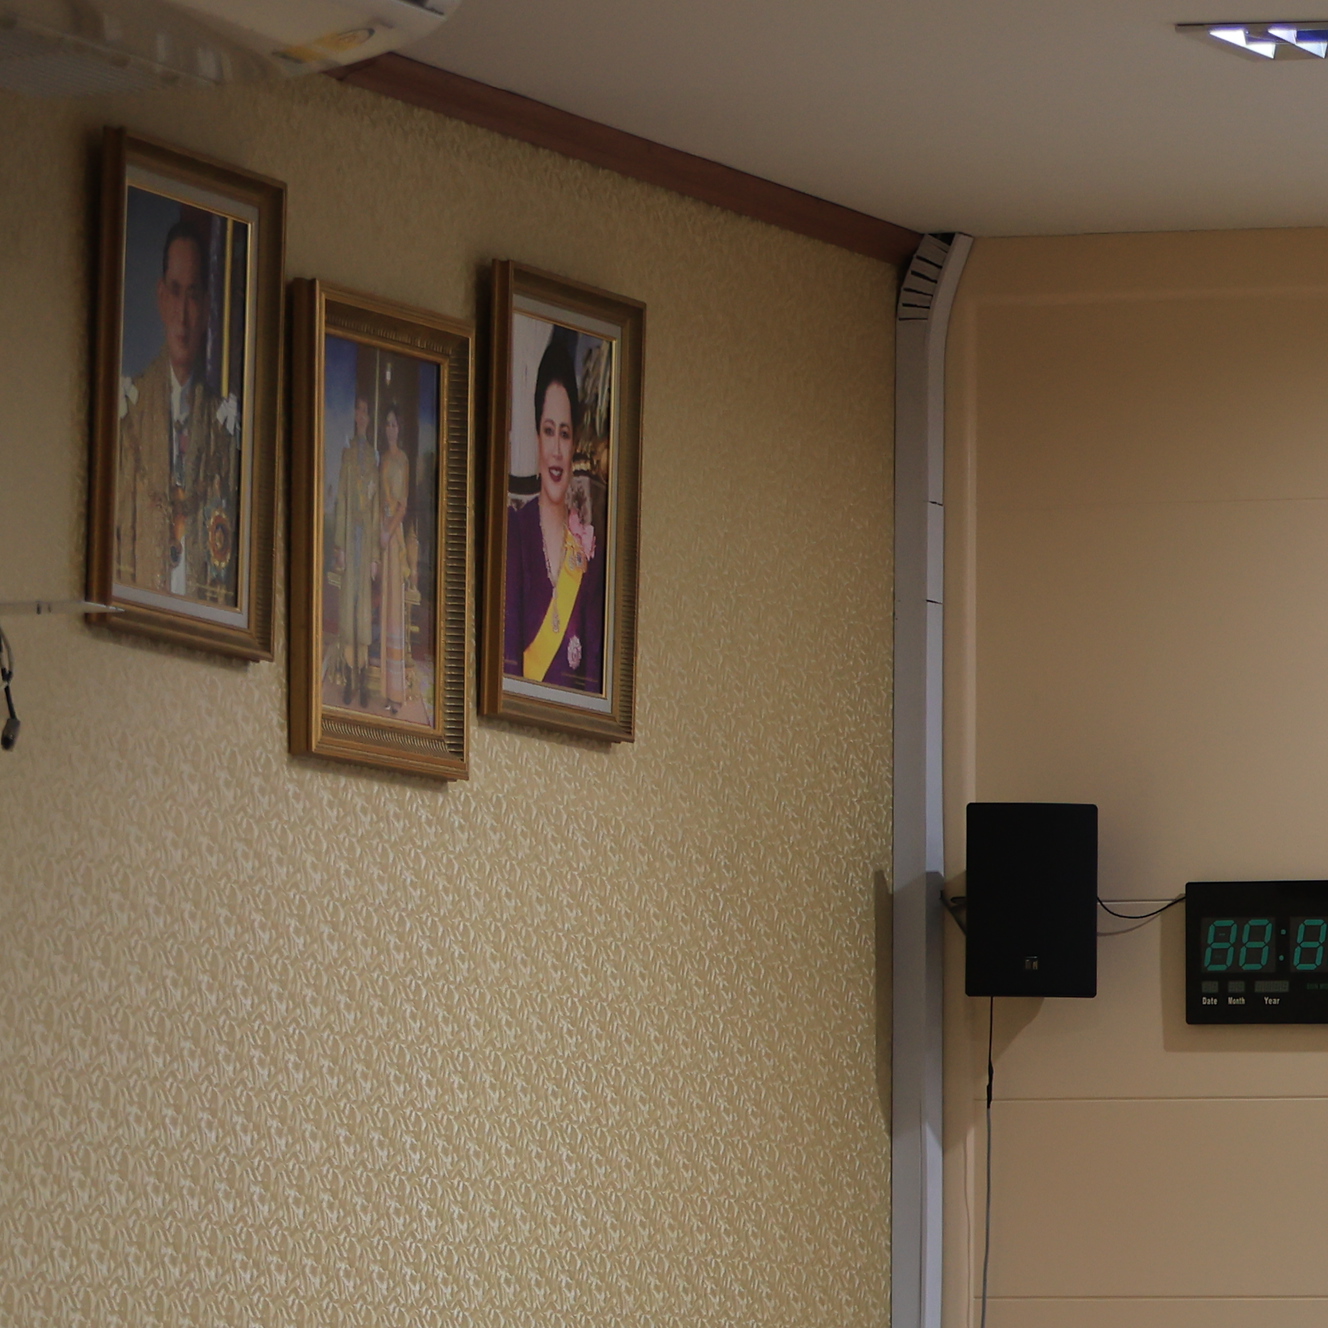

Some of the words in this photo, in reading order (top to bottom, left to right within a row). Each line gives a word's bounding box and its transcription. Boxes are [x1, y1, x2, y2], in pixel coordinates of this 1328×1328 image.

[1201, 995, 1217, 1005] Date
[1227, 995, 1245, 1005] Month
[1263, 995, 1280, 1005] Year
